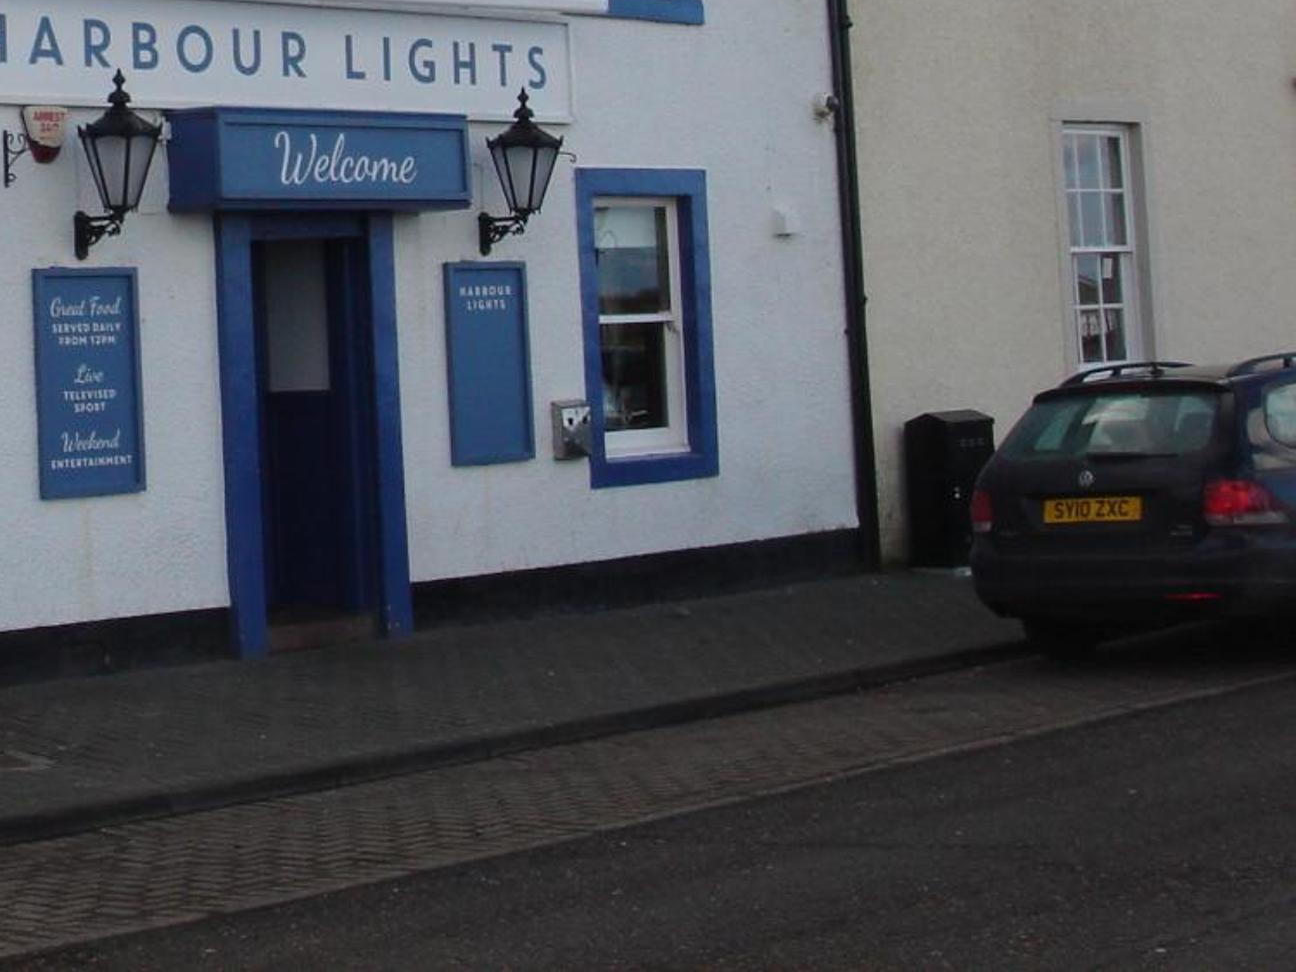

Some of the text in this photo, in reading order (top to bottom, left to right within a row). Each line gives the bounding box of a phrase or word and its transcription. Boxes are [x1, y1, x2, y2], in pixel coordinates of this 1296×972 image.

[345, 33, 548, 90] LIGHTS
[274, 131, 417, 185] Welcome
[459, 285, 512, 296] HARBOUR
[50, 295, 121, 317] Great Food
[466, 299, 506, 311] LIGHTS
[52, 322, 121, 334] SERVED DAILY
[58, 334, 116, 346] FROM 12PM
[74, 364, 104, 384] Live
[64, 390, 117, 401] TELEVISED
[74, 401, 106, 413] SPORT
[61, 429, 120, 453] Weekend
[51, 456, 132, 470] ENTERTAINMENT
[1054, 499, 1129, 520] SY10 ZXC
